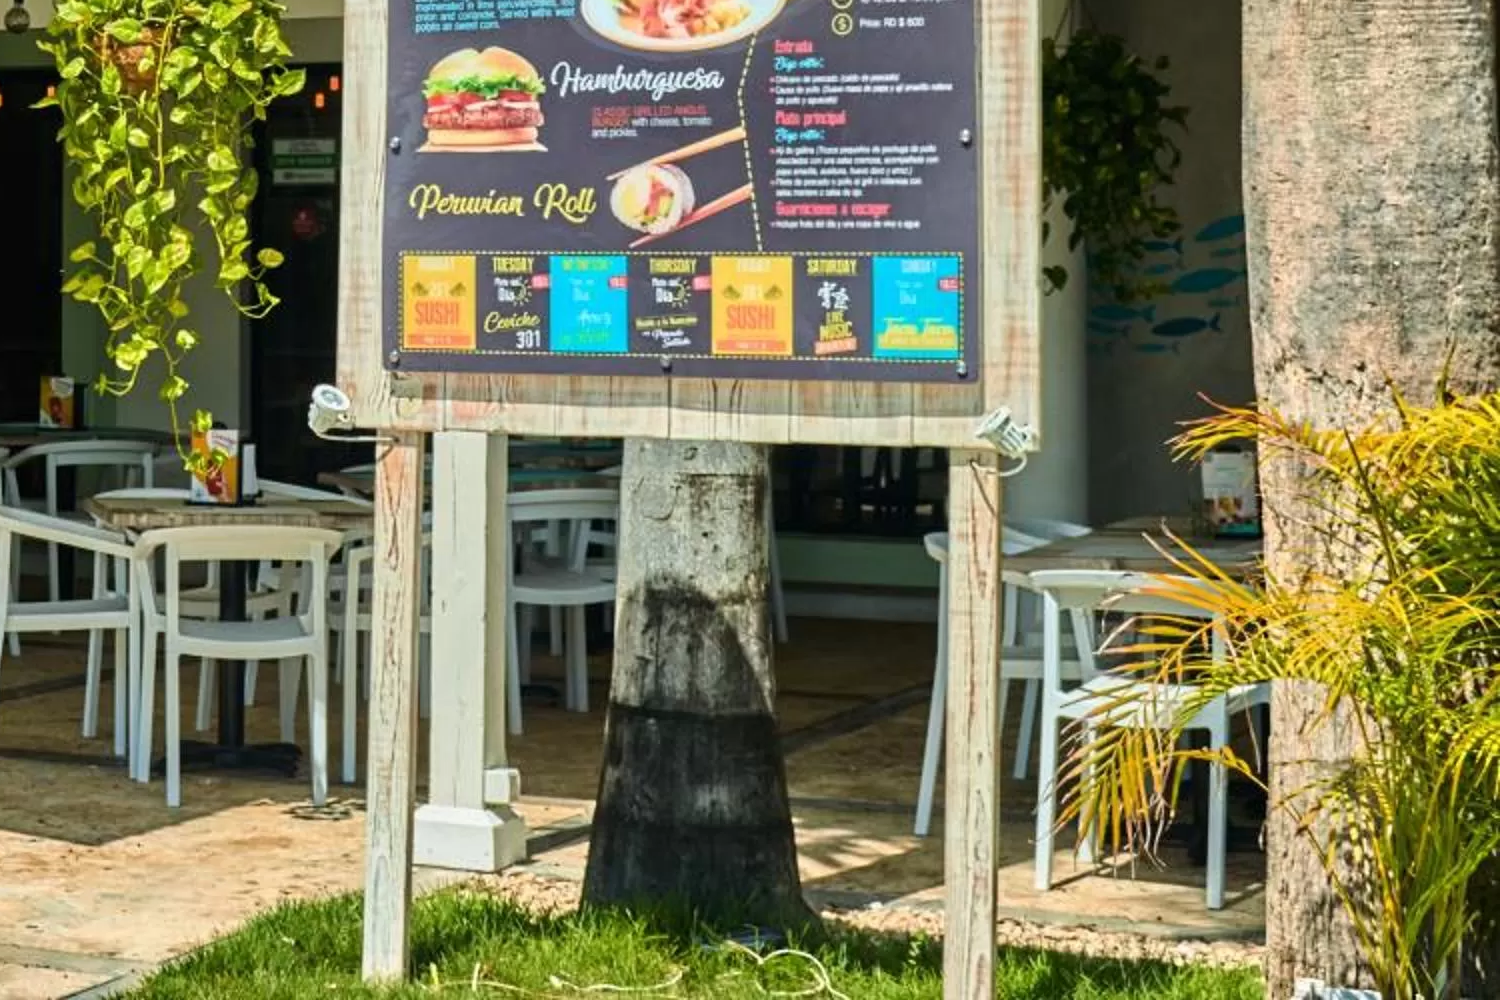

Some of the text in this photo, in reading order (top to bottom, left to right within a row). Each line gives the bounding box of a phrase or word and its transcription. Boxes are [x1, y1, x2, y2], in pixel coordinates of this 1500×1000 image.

[898, 17, 905, 27] $
[550, 61, 725, 101] Hamburguesa
[409, 183, 597, 224] Peruvian Roll
[414, 301, 460, 326] SUSHI
[483, 311, 541, 333] Ceviche
[726, 304, 775, 330] SUSHI
[516, 329, 541, 349] 301
